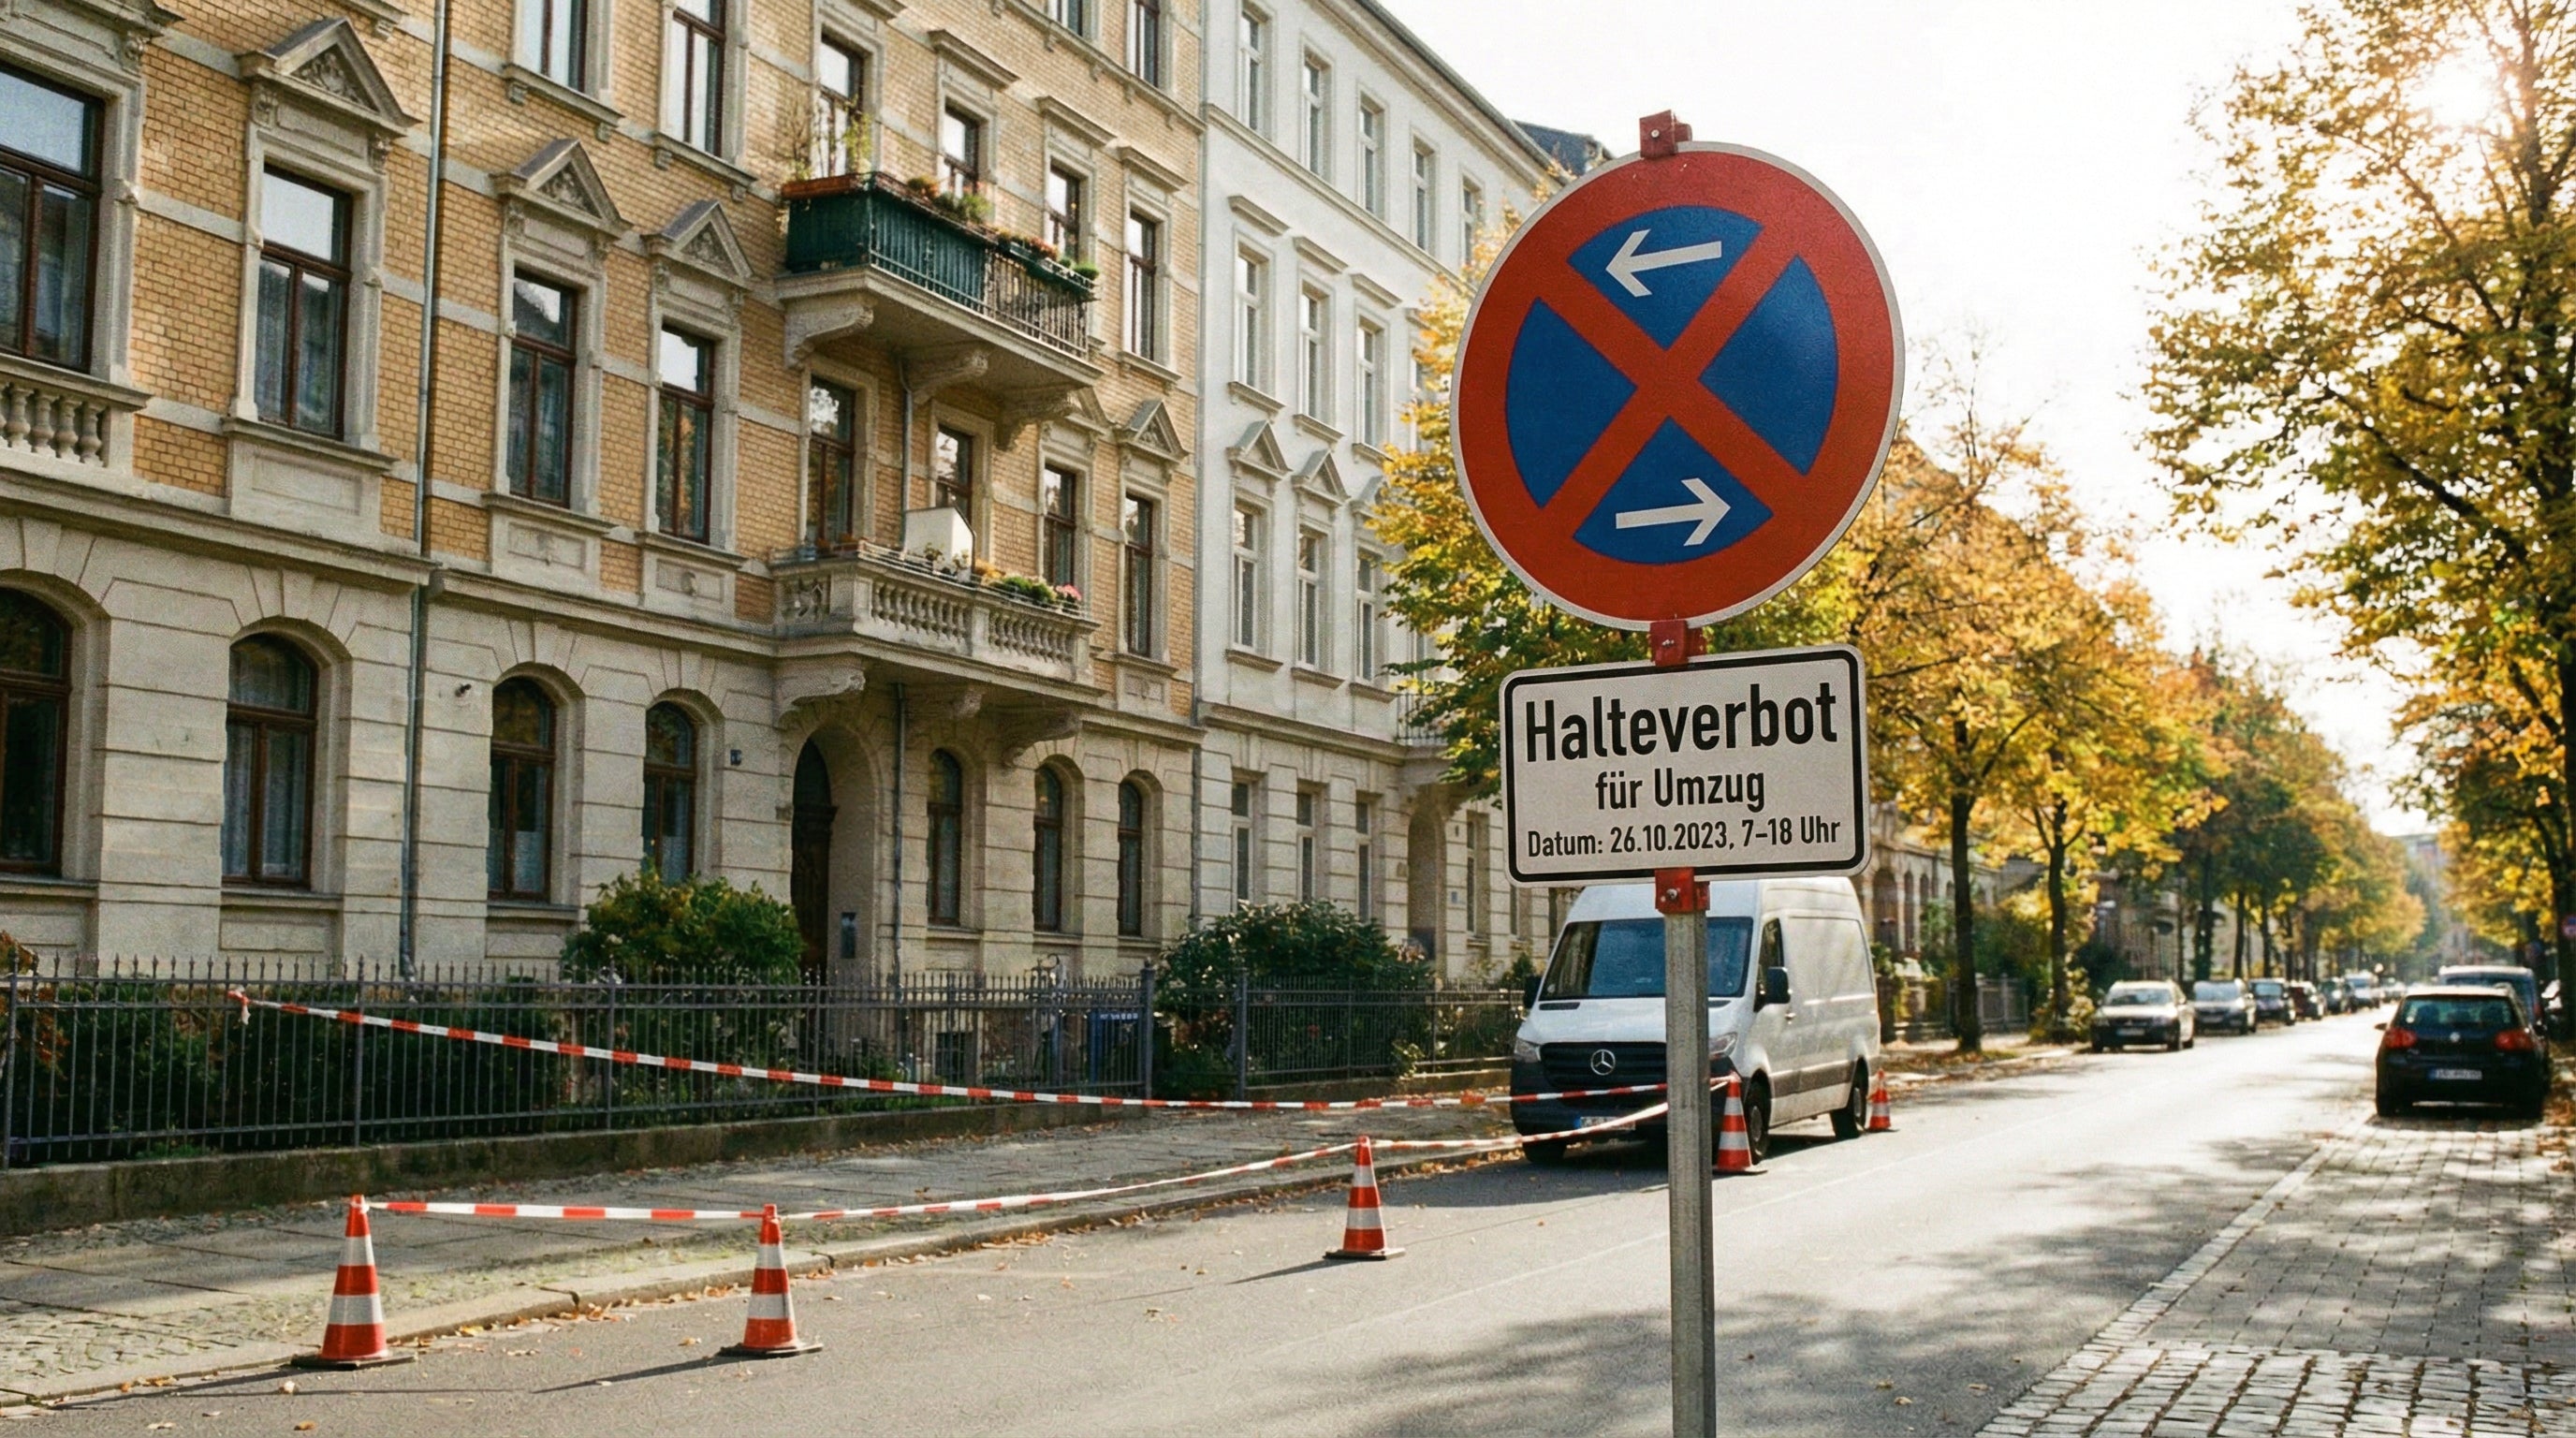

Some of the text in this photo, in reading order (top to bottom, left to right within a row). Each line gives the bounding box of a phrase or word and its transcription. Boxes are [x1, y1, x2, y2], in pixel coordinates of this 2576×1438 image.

[1526, 682, 1837, 762] Halteverbot
[1595, 768, 1765, 813] für Umzug
[1528, 830, 1603, 858] Datum:
[1610, 821, 1734, 854] 26.10.2023,
[1800, 815, 1841, 844] Uhr
